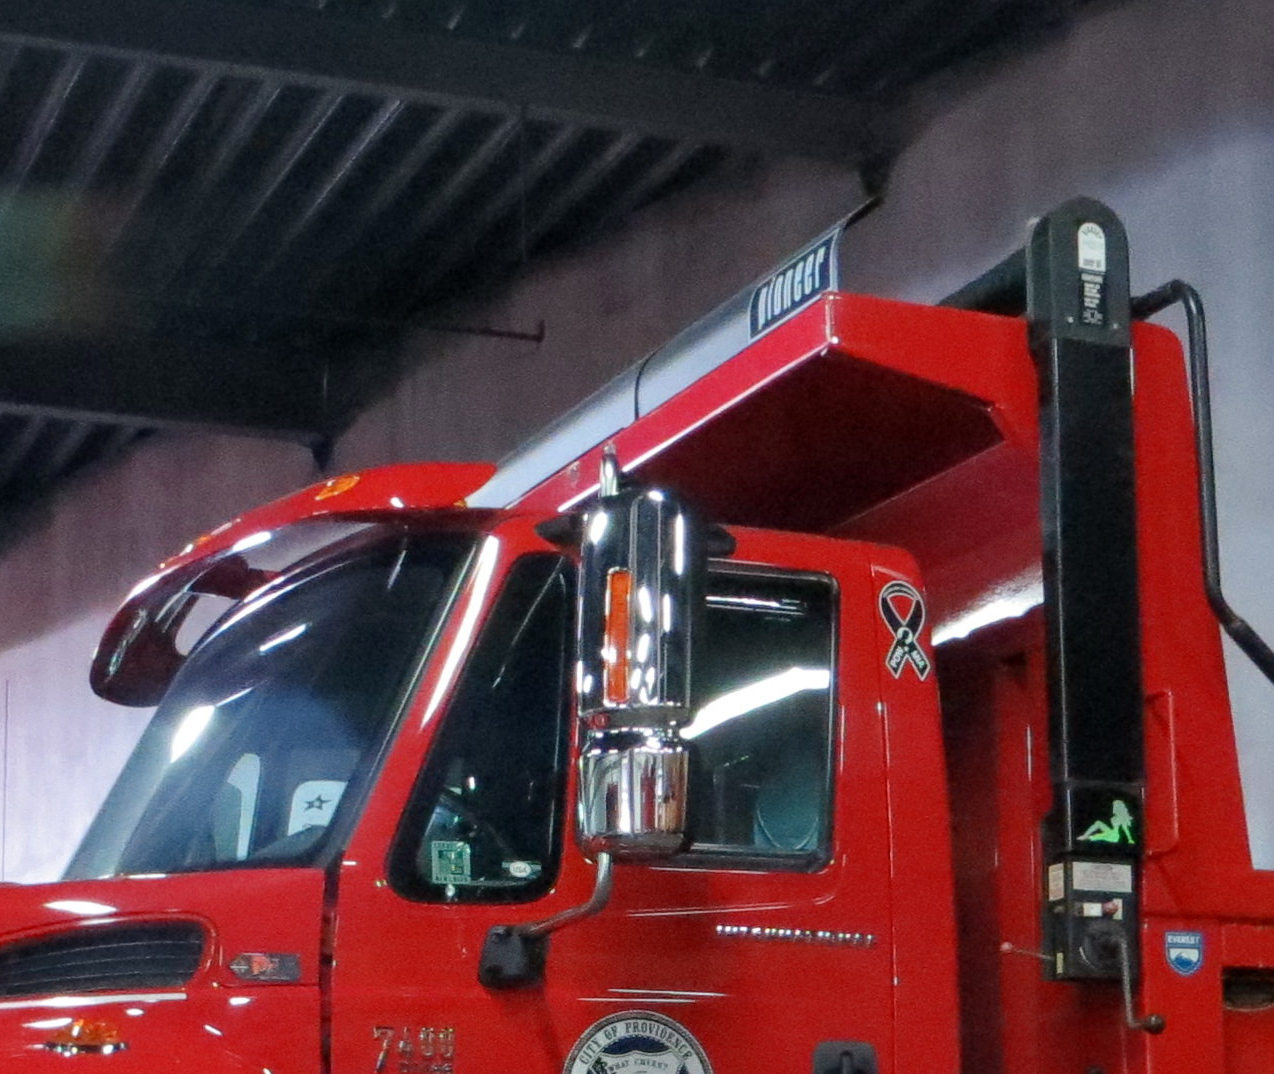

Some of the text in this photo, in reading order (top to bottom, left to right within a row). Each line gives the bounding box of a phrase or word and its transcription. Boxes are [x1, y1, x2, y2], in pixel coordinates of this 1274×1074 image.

[890, 645, 904, 668] POW
[579, 1021, 694, 1066] CITY OF PROVIDENCE
